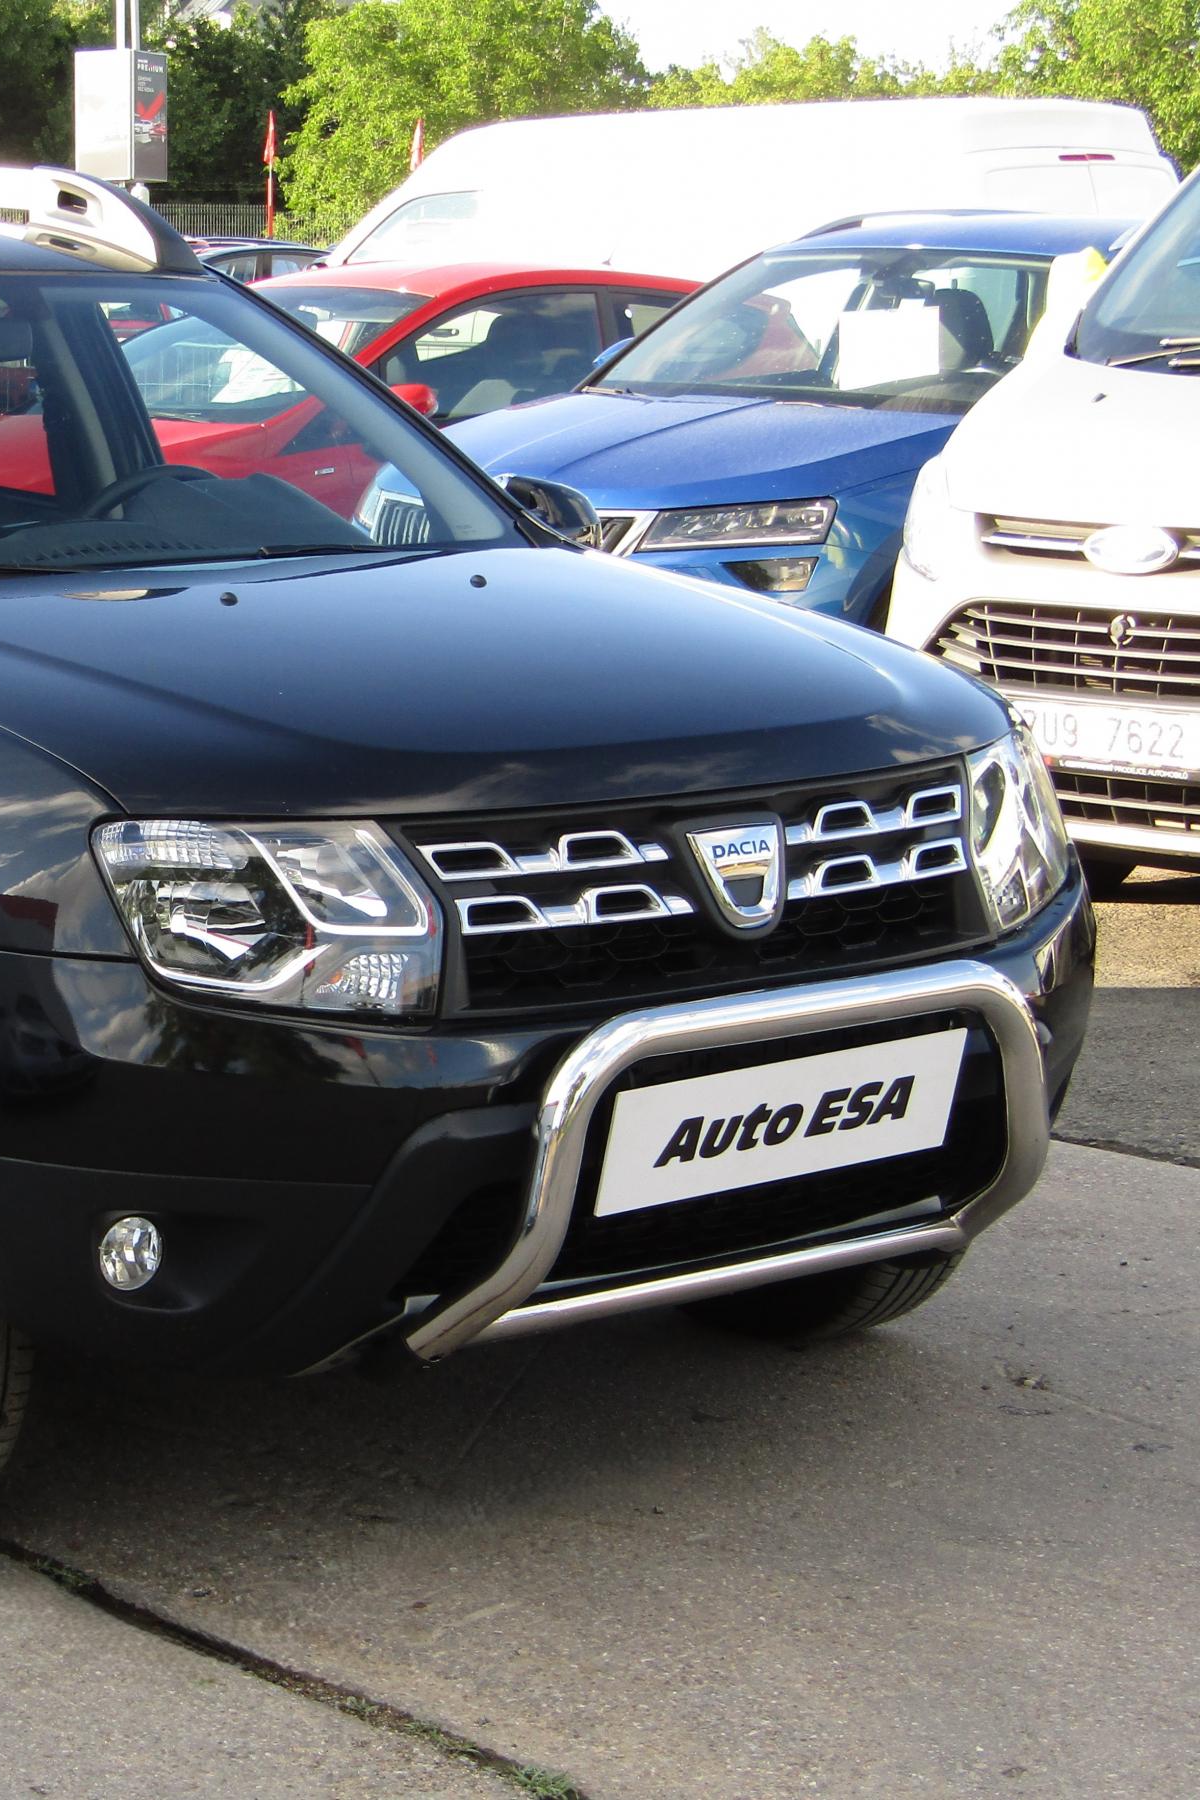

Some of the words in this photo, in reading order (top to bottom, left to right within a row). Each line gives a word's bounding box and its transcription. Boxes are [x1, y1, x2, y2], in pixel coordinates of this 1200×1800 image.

[1107, 717, 1184, 759] 7622
[711, 839, 771, 859] DACIA
[653, 1102, 804, 1169] Auto
[803, 1074, 916, 1138] ESA
